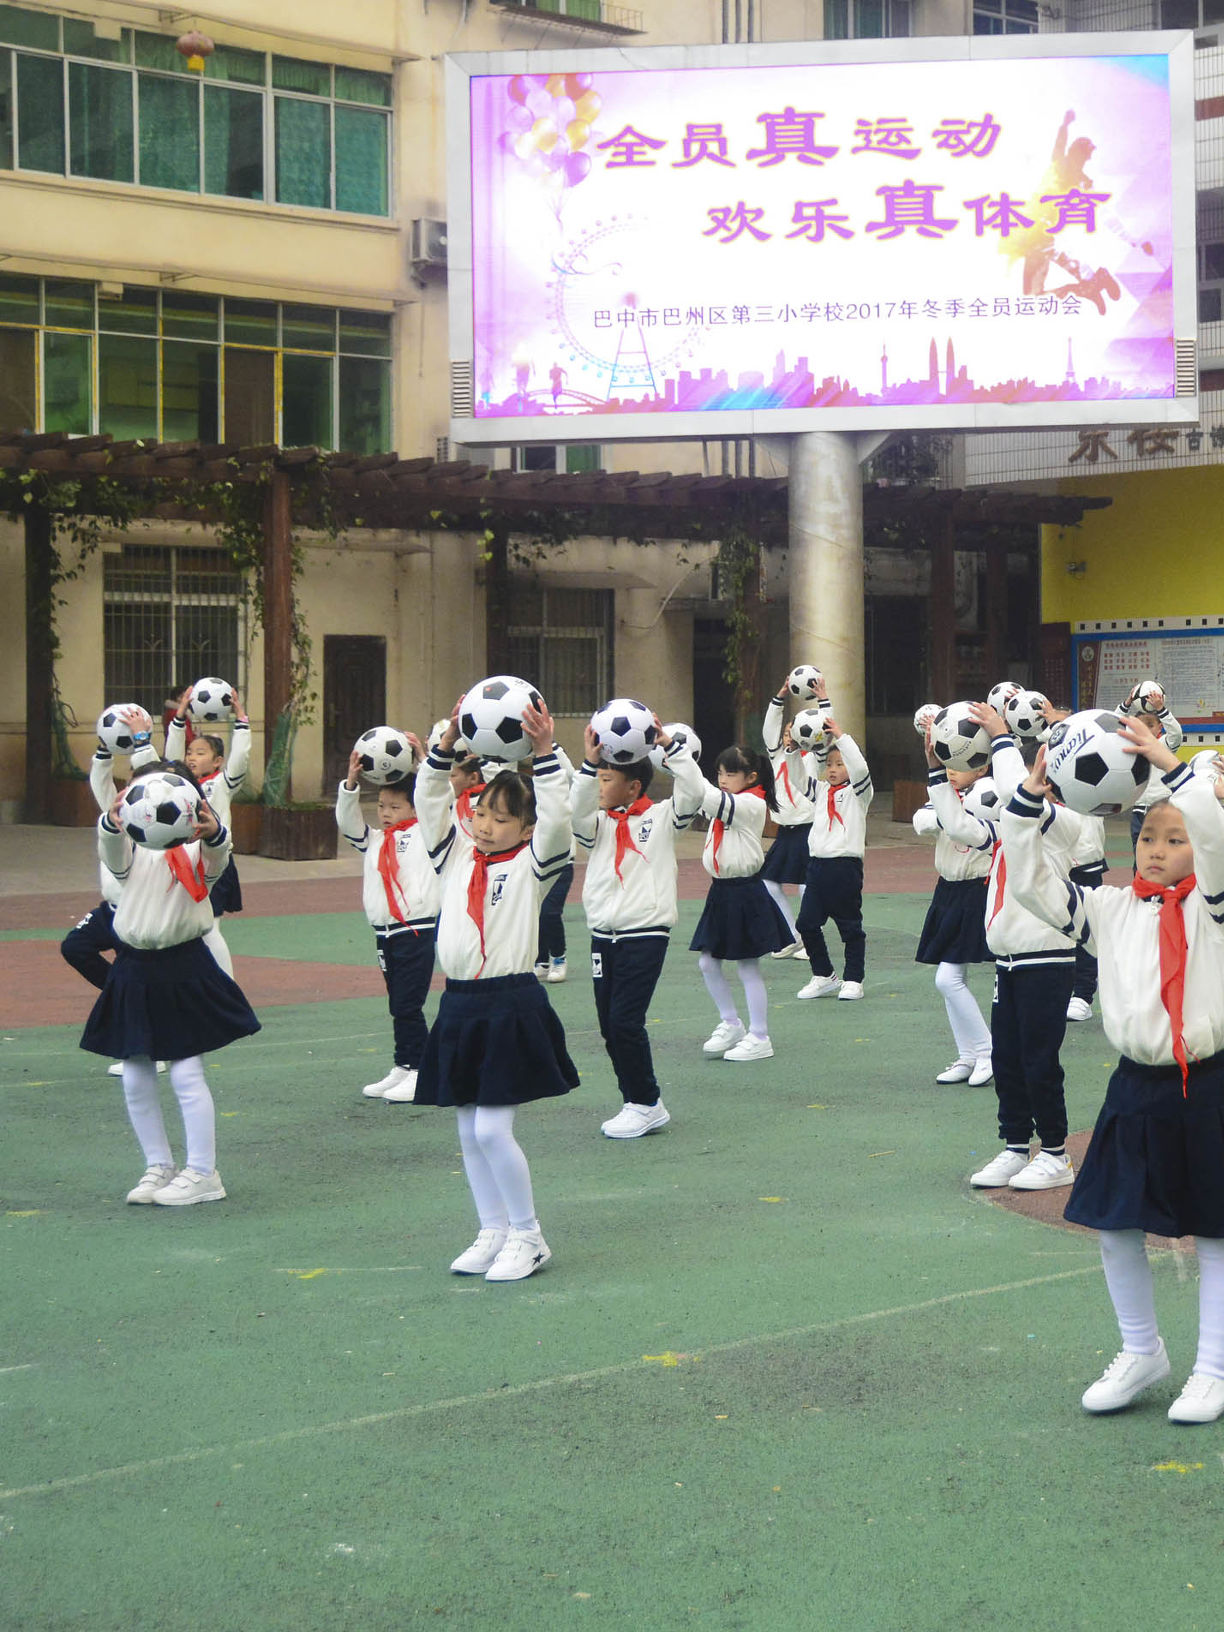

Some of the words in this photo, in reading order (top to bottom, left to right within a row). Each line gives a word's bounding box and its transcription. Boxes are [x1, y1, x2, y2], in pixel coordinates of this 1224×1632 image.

[596, 106, 1001, 169] 全员真运动
[702, 179, 1112, 243] 欢乐真体育
[593, 295, 1082, 328] 巴中市巴州区第三小学校2017年冬季全员运动会
